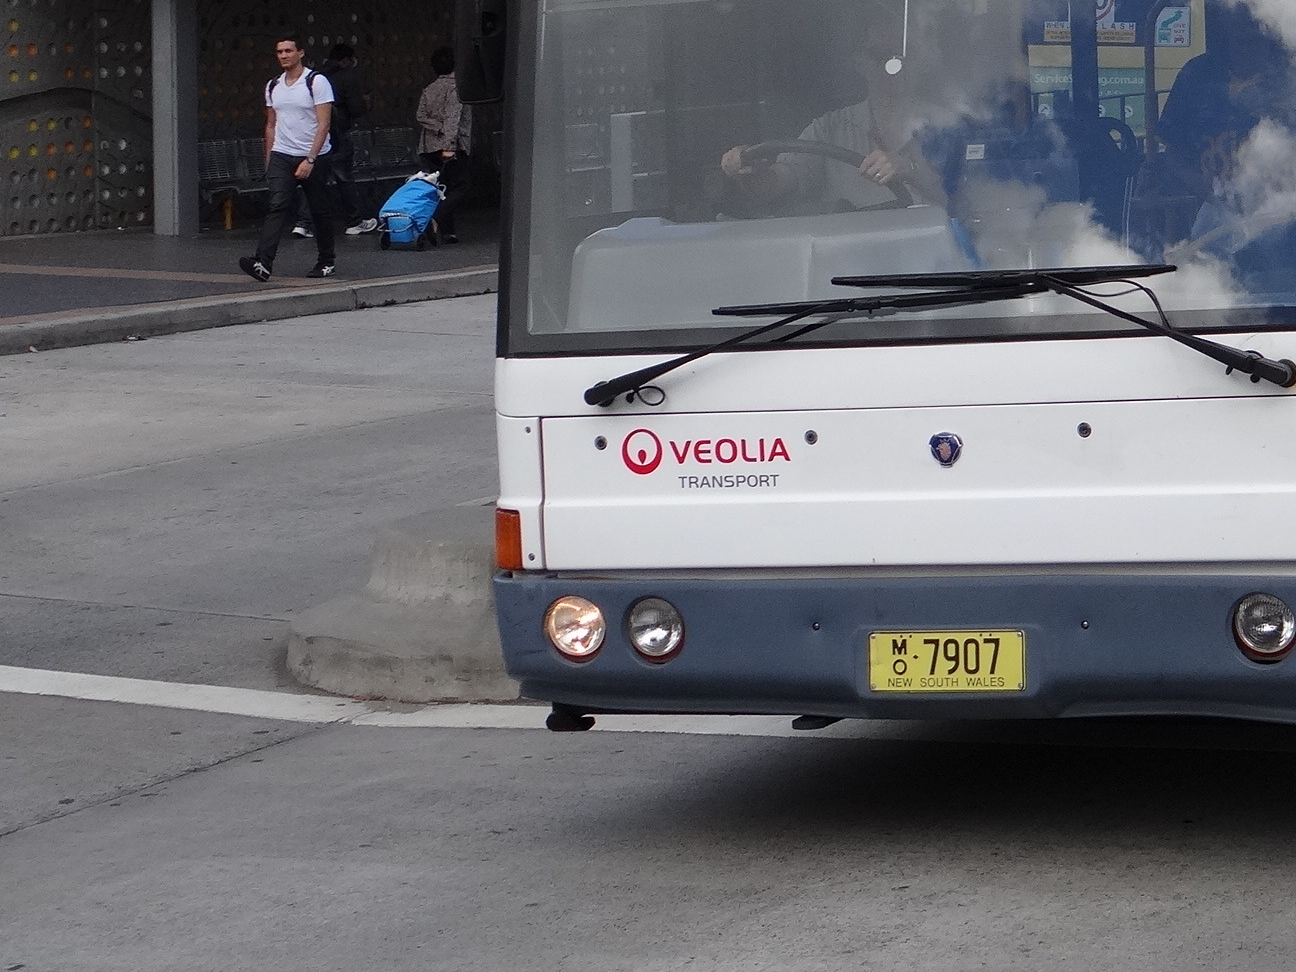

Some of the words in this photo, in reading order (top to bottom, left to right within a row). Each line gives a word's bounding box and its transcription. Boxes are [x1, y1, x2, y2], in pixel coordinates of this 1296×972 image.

[668, 437, 791, 465] VEOLIA
[678, 474, 780, 489] TRANSPORT
[923, 637, 1001, 676] 7907
[887, 678, 913, 688] NEW
[920, 677, 959, 688] SOUTH
[967, 676, 1005, 687] WALES
